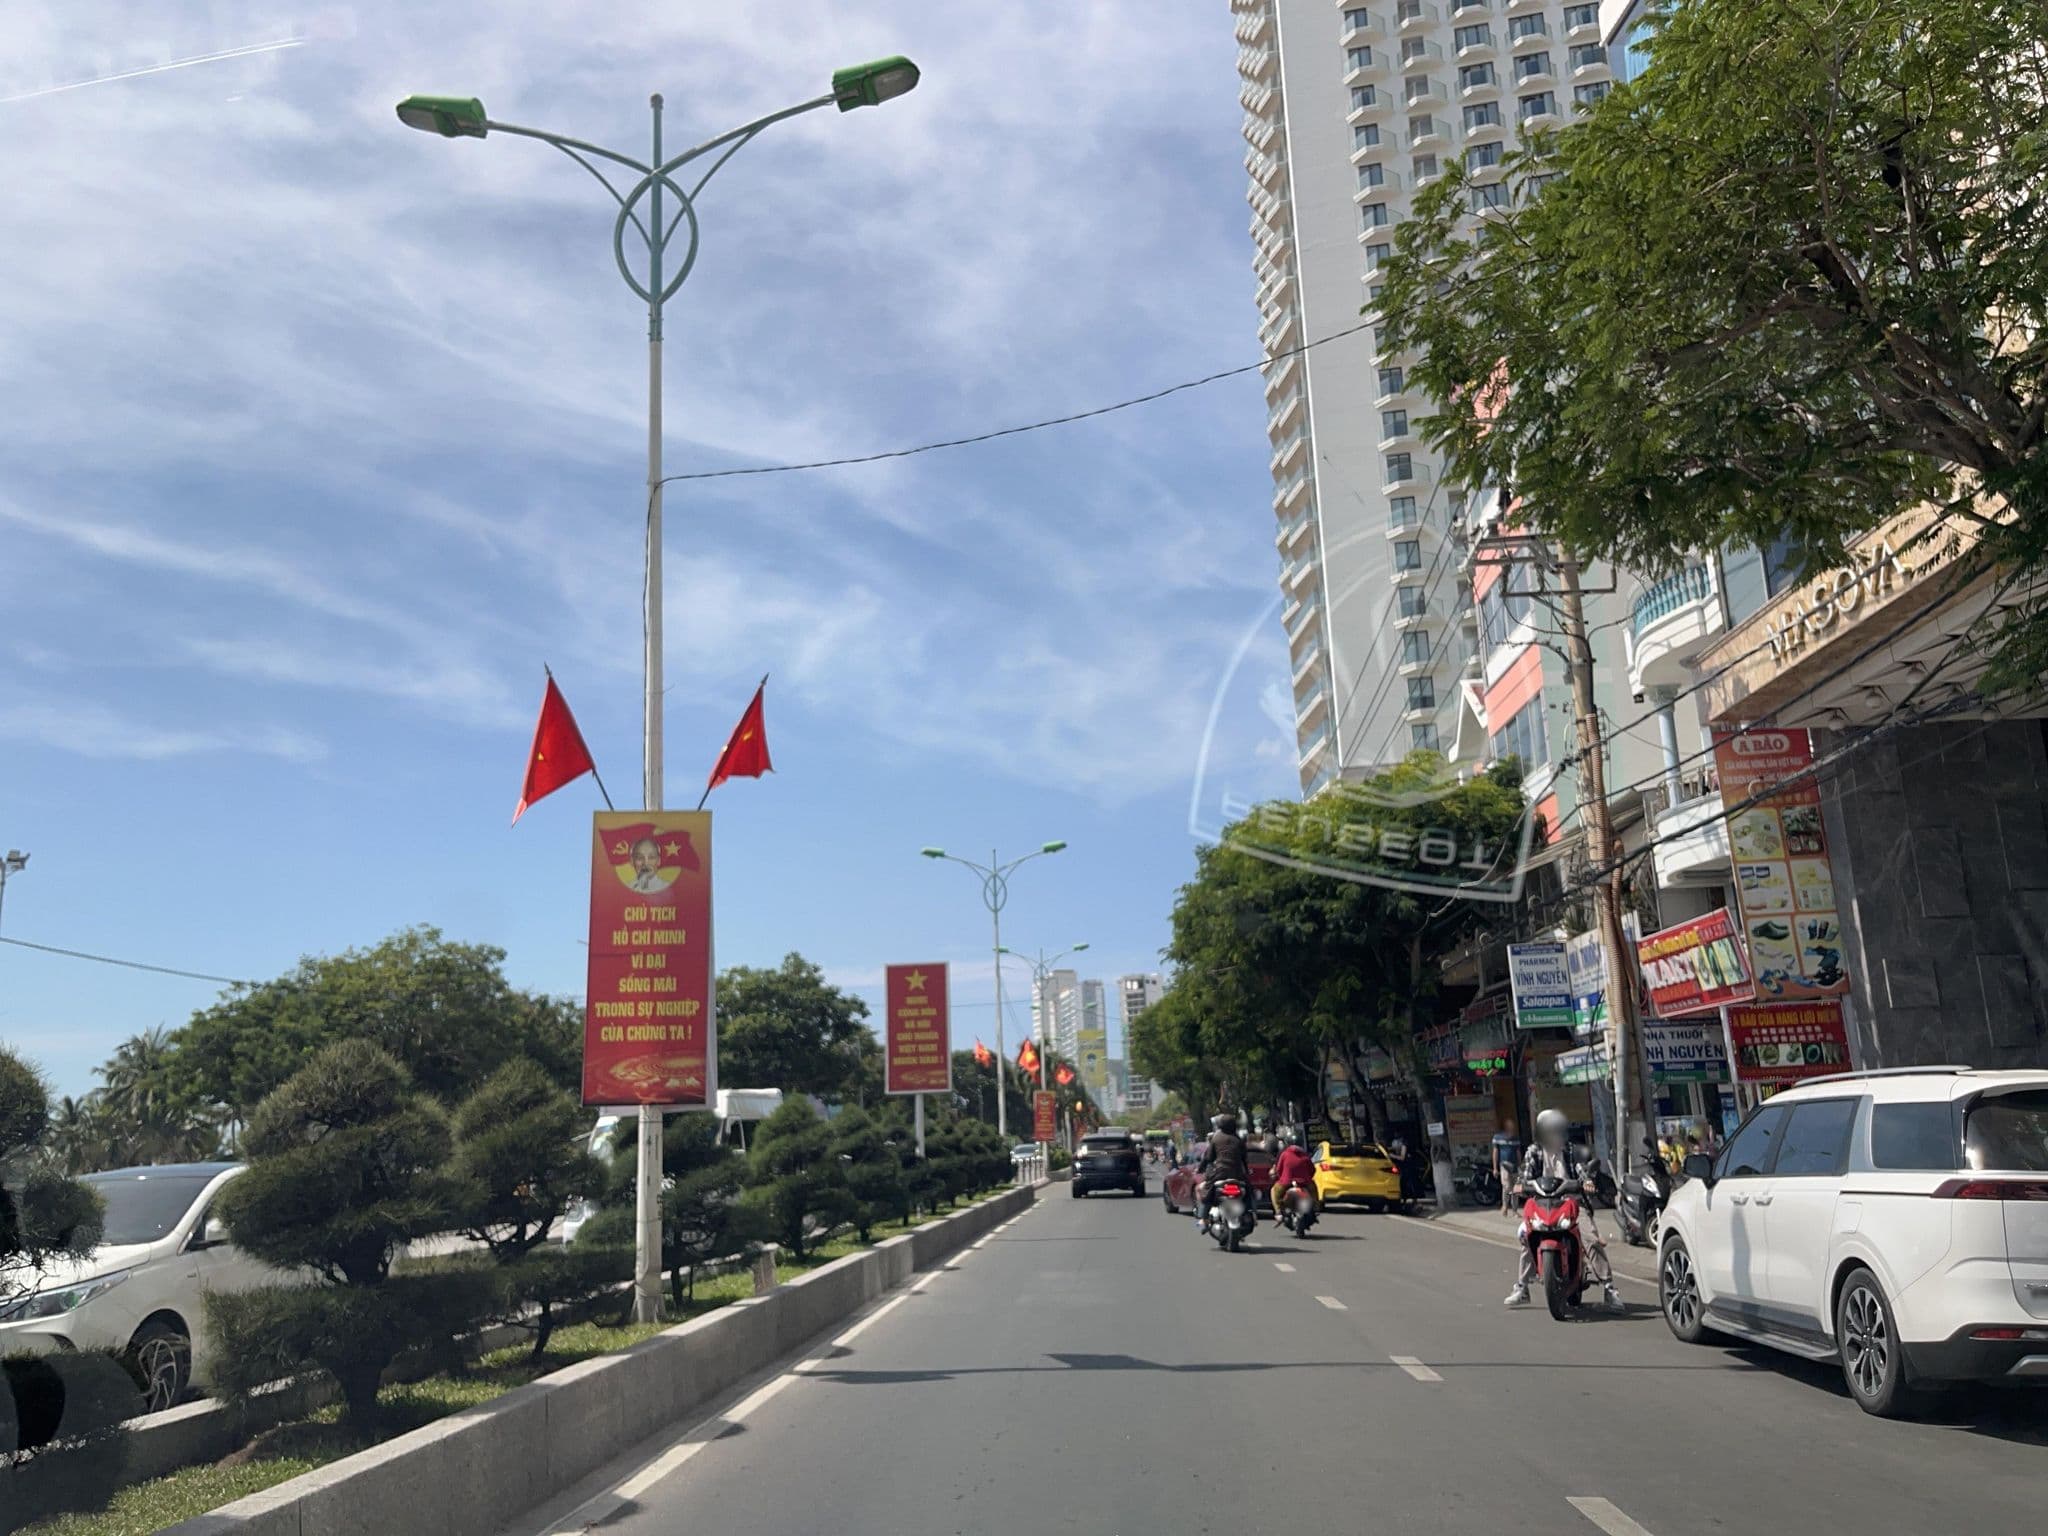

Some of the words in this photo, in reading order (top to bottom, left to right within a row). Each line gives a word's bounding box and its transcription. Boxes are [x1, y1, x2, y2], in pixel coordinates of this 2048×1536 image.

[624, 902, 647, 922] CHỦ
[650, 906, 676, 923] TỊCH
[612, 925, 629, 946] HỒ
[631, 928, 651, 945] CHÍ
[654, 929, 686, 945] MINH
[646, 953, 666, 971] ĐẠI
[1518, 957, 1559, 967] PHARMACY
[619, 973, 651, 992] SỐNG
[595, 1001, 635, 1017] TRONG
[638, 1001, 654, 1019] SỰ
[656, 998, 700, 1018] NGHIỆP
[1522, 995, 1567, 1008] Salonpas
[601, 1022, 624, 1042] CỦA
[627, 1023, 666, 1041] CHÚNG
[670, 1025, 685, 1041] TA
